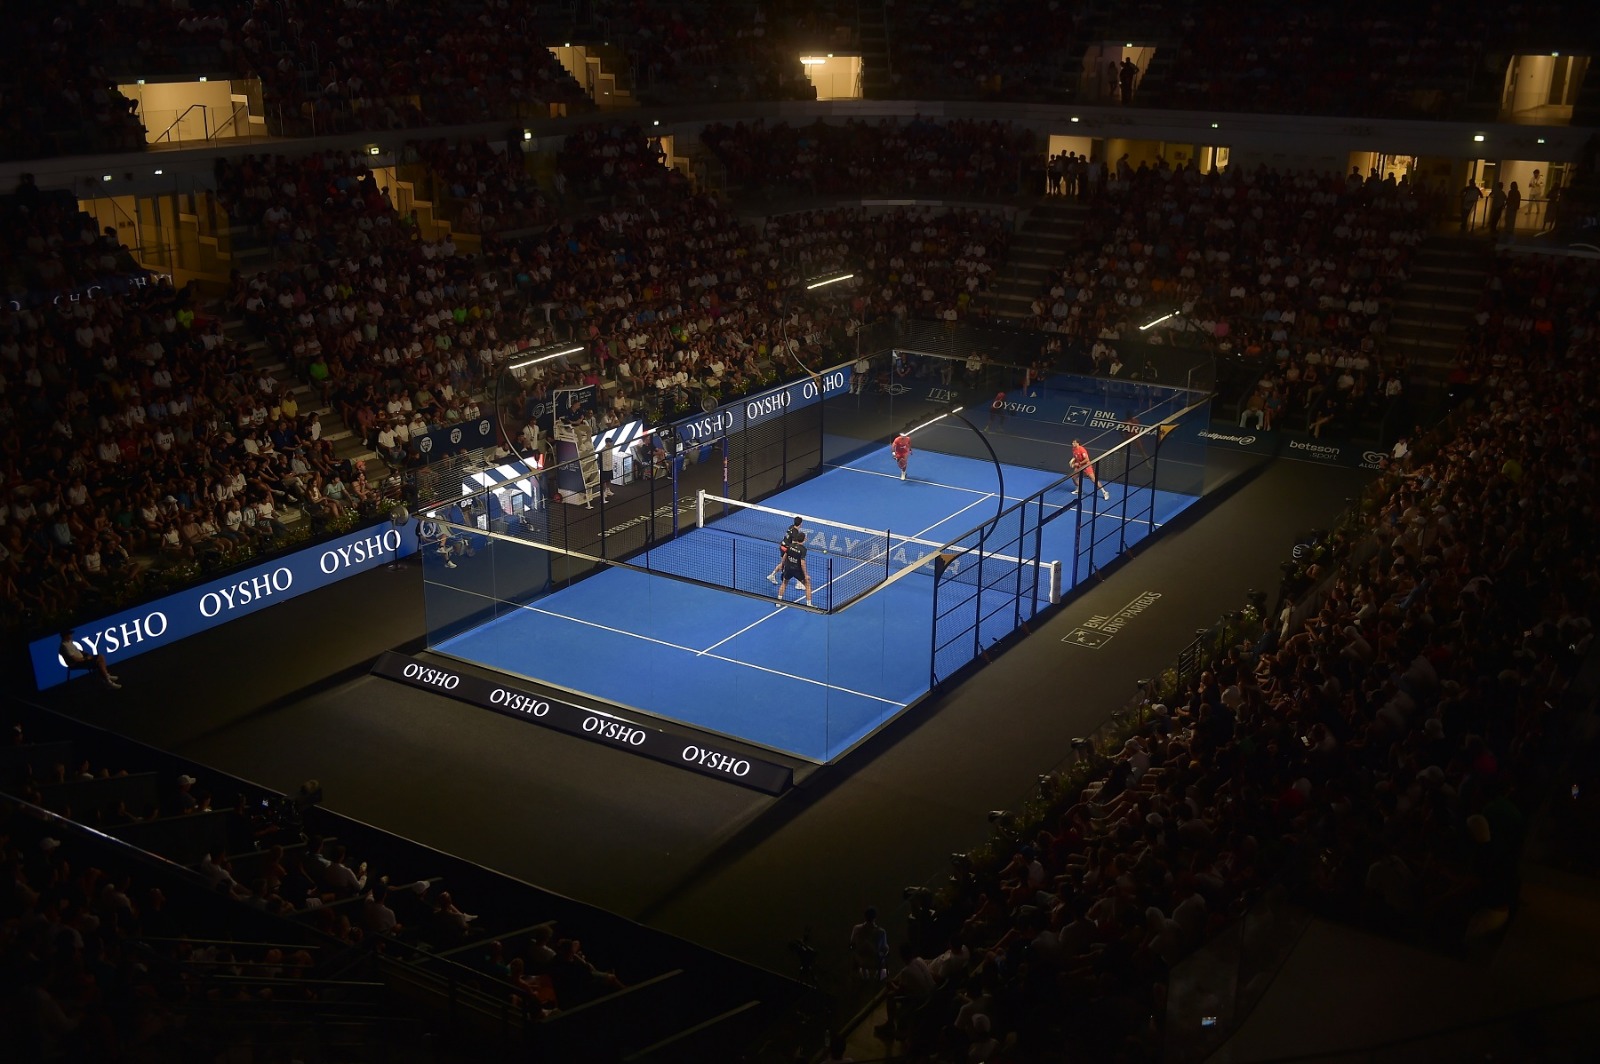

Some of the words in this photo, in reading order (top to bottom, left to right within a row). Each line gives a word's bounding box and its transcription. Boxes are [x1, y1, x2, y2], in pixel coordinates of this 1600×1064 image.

[747, 391, 791, 420] OYSHO
[928, 387, 951, 401] ITA
[992, 400, 1037, 414] OYSHO
[1089, 419, 1115, 430] BNP
[1094, 410, 1117, 420] BNL
[1289, 440, 1340, 454] betsson
[1358, 462, 1381, 470] ALGID
[319, 529, 402, 574] OYSHO
[799, 527, 860, 553] TALY
[199, 567, 293, 617] OYSHO
[1083, 614, 1109, 629] BNL
[1103, 617, 1127, 634] BNP
[1121, 591, 1162, 619] PARIBAS
[58, 611, 168, 668] YSHO
[403, 663, 460, 690] OYSHO
[489, 688, 550, 717] OYSHO
[582, 716, 646, 746] OYSHO
[682, 745, 751, 777] OYSHO
